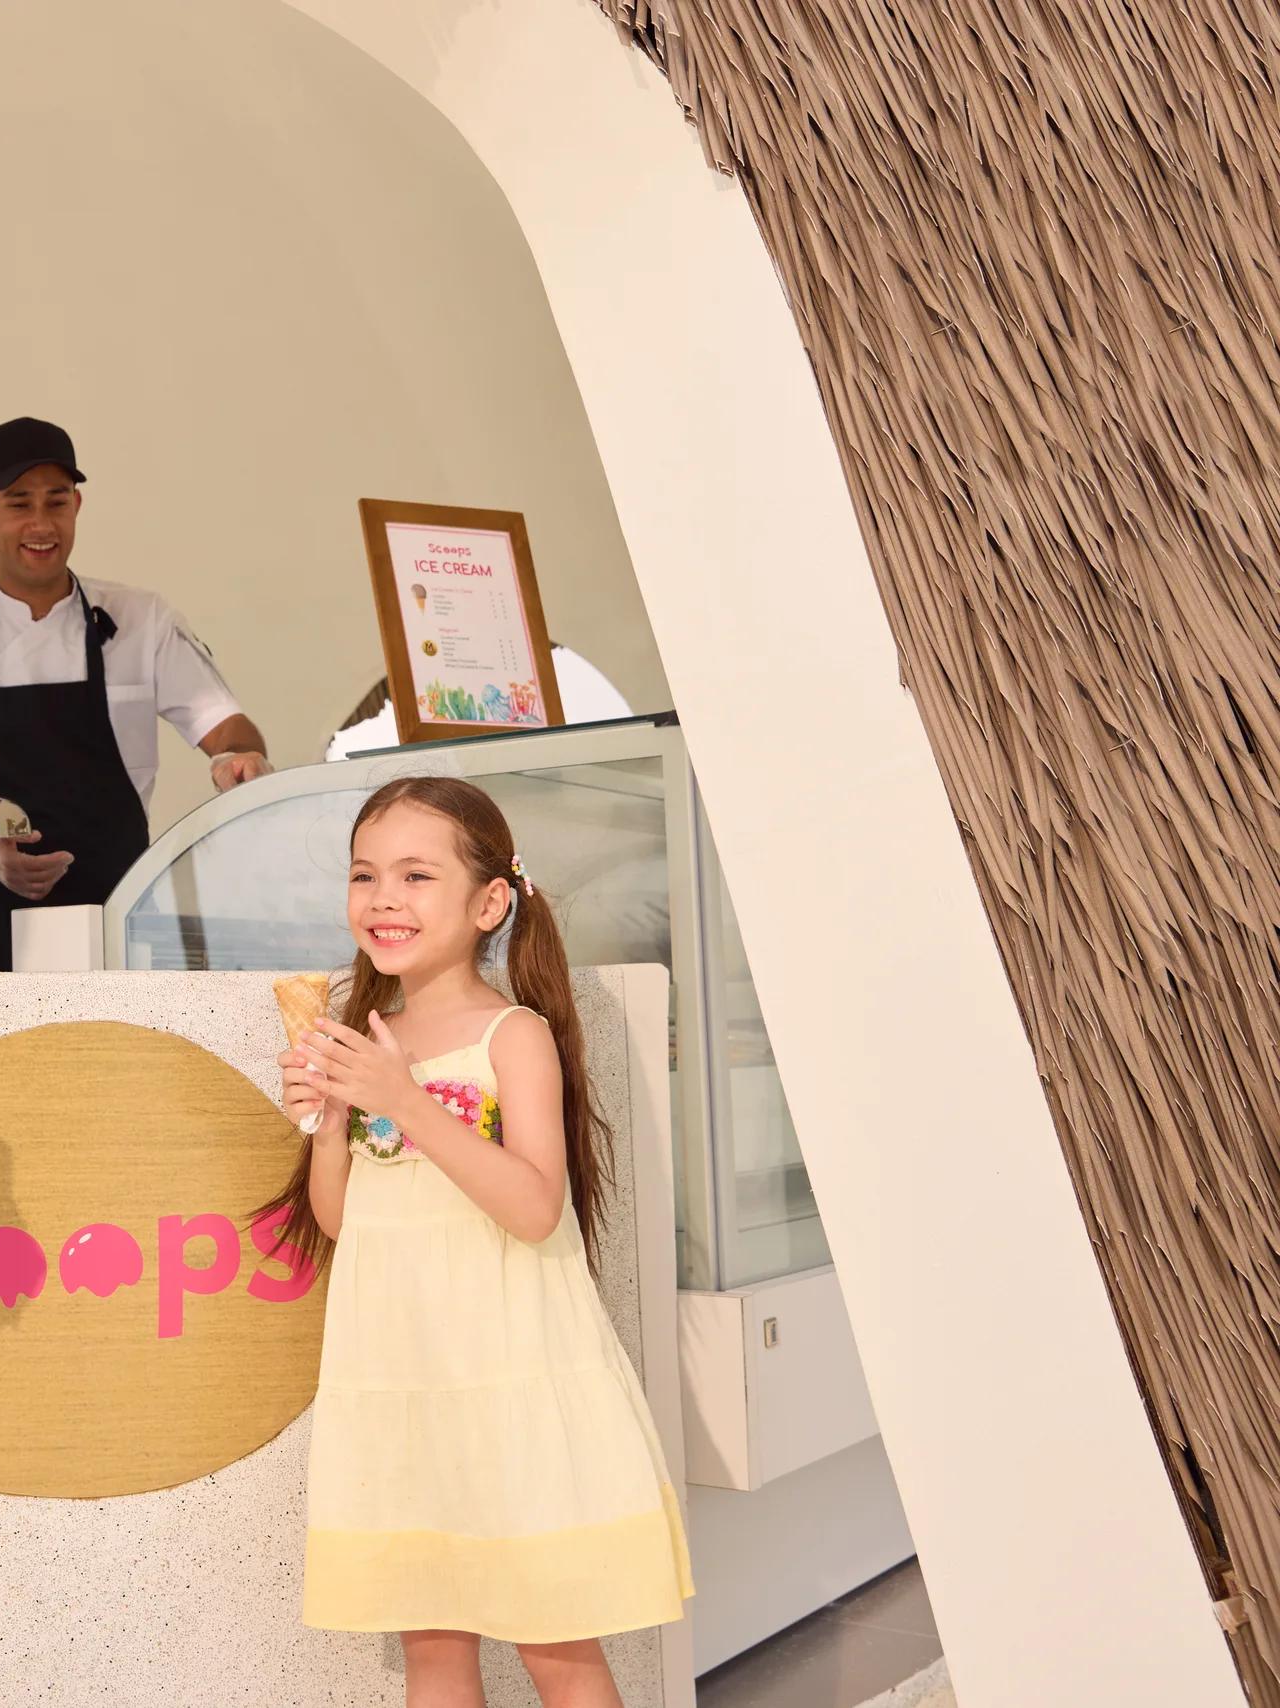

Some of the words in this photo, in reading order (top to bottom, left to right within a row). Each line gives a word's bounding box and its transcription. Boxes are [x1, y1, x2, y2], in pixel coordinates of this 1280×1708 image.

[428, 542, 472, 557] Scoops
[414, 559, 440, 574] ICE
[442, 561, 493, 577] CREAM
